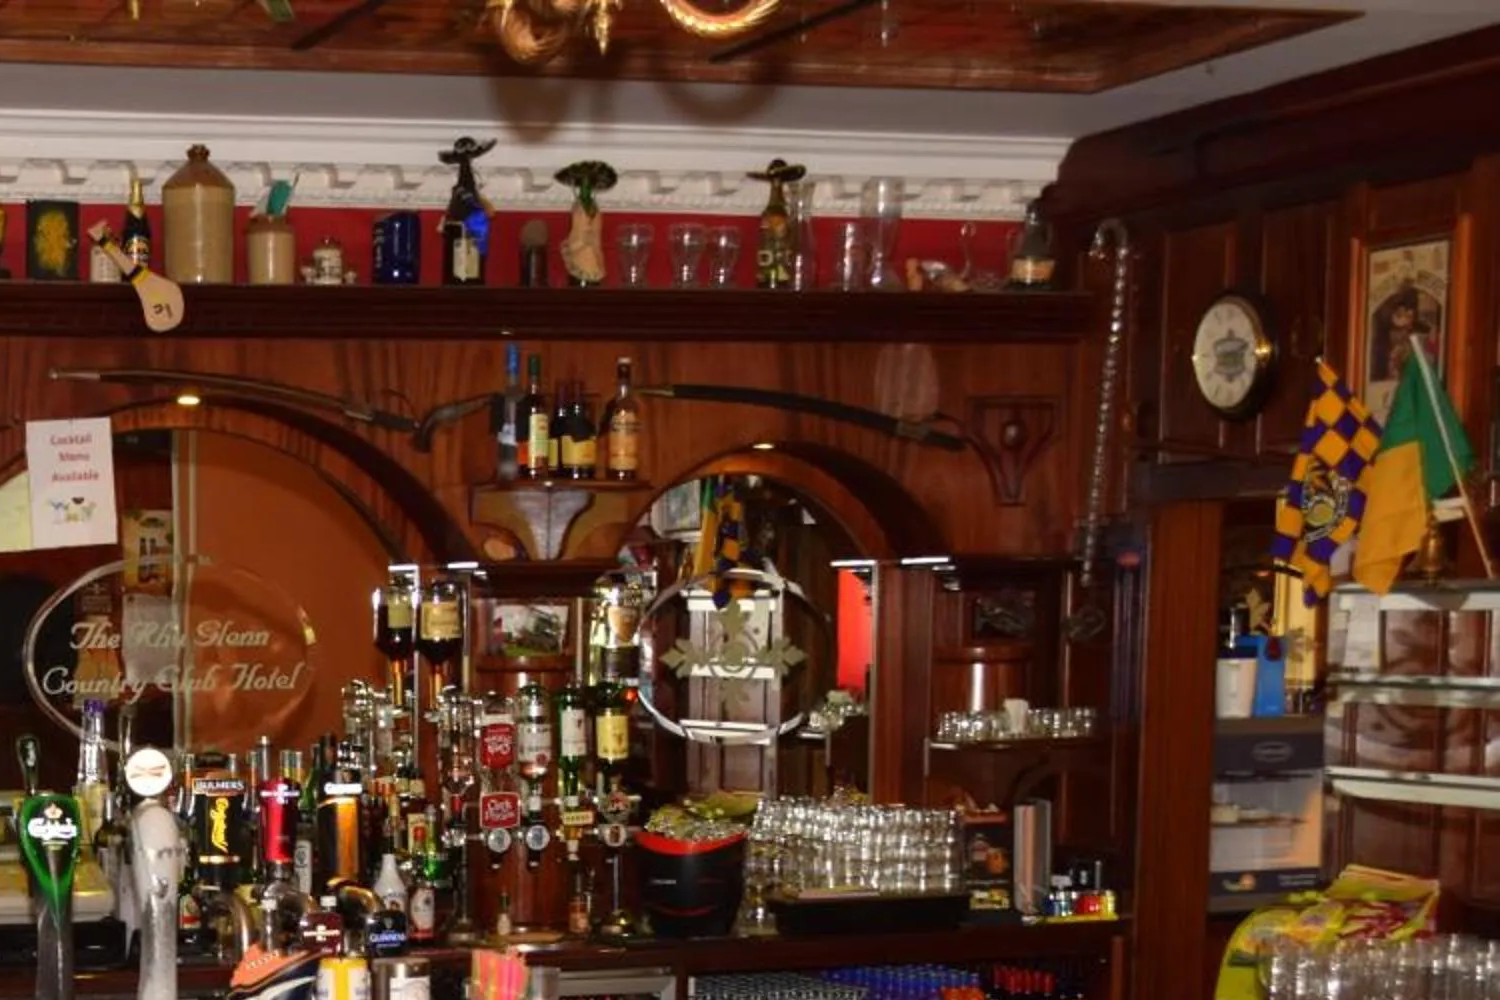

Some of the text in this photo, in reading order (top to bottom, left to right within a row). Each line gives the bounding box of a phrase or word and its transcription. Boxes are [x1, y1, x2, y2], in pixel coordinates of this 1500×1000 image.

[50, 432, 93, 446] Cocktail
[52, 469, 99, 481] Available
[69, 621, 121, 650] The
[194, 620, 270, 647] Glenn
[43, 661, 304, 705] Country Club Hotel
